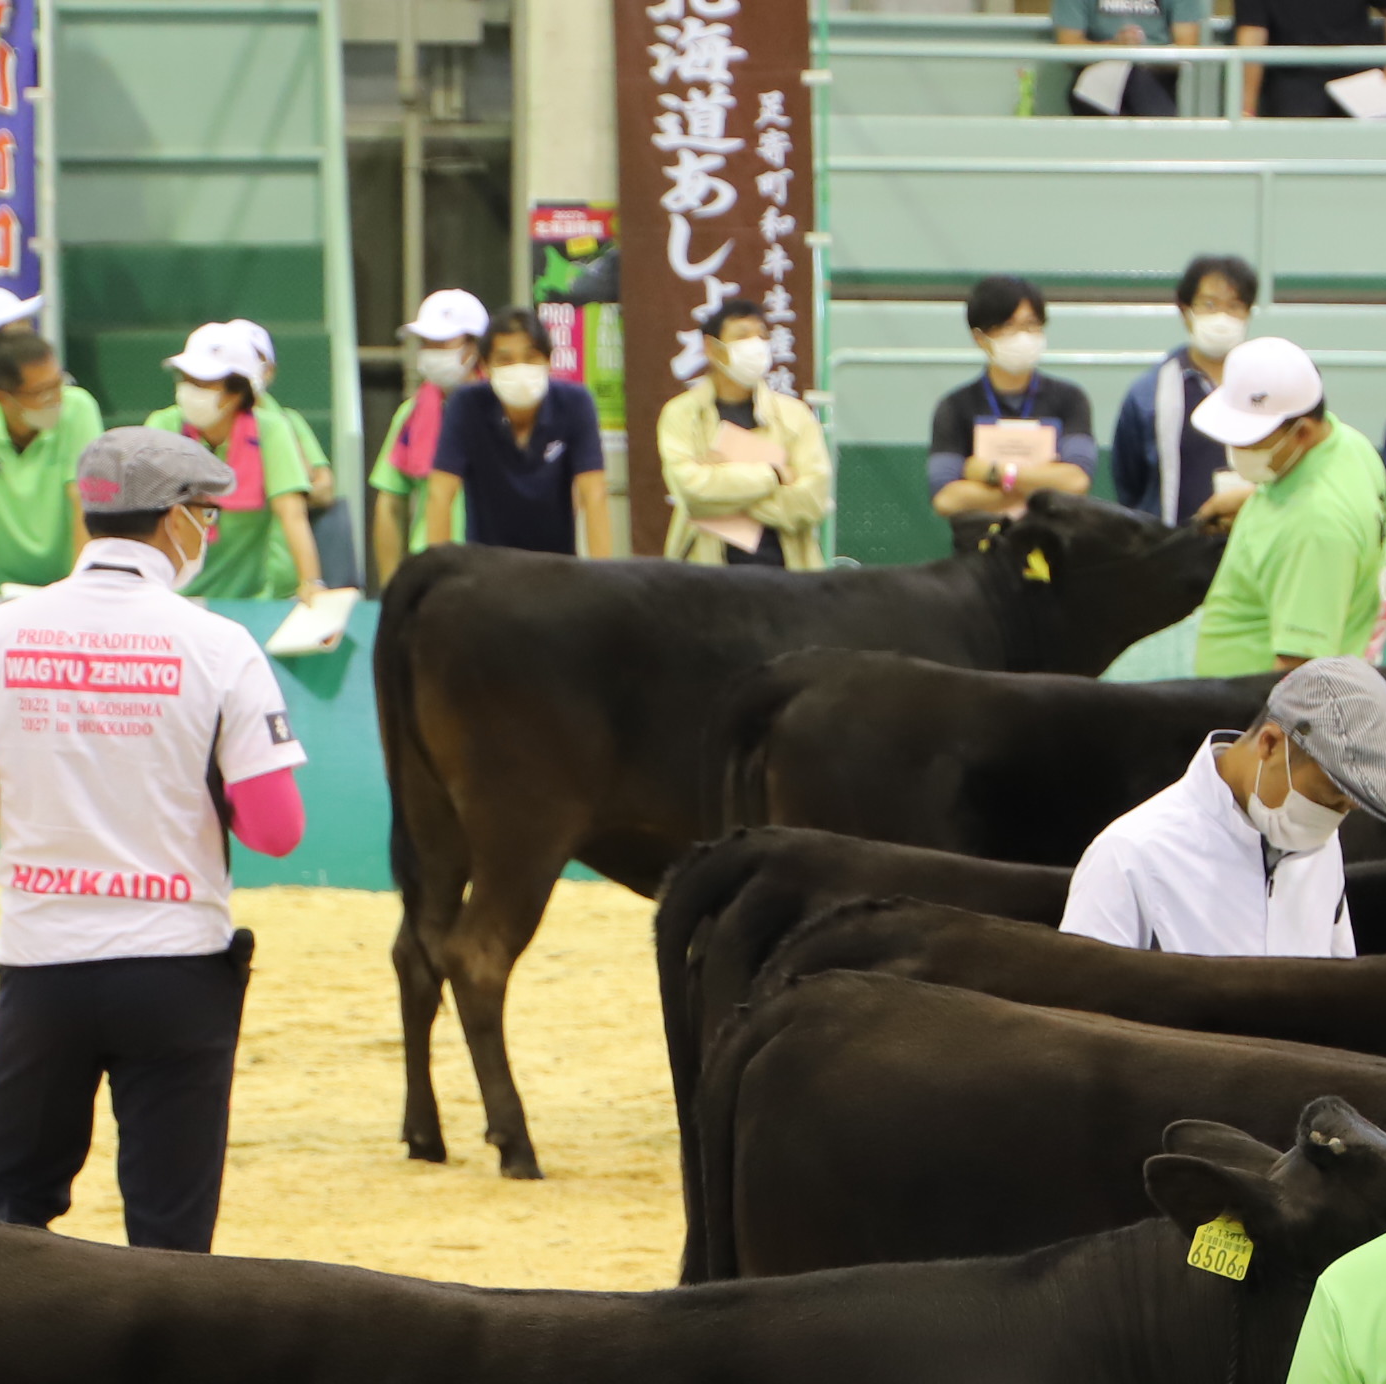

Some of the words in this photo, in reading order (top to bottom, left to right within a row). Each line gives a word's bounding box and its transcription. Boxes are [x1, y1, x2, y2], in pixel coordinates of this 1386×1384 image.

[6, 657, 85, 684] WAGYU
[88, 660, 179, 688] ZENKYO
[17, 697, 49, 713] 2022
[56, 698, 71, 714] in
[76, 700, 163, 717] KAGOSHIMA
[56, 718, 70, 733] in
[76, 718, 154, 736] HOKKAIDO
[13, 864, 192, 903] HOKKAIDO
